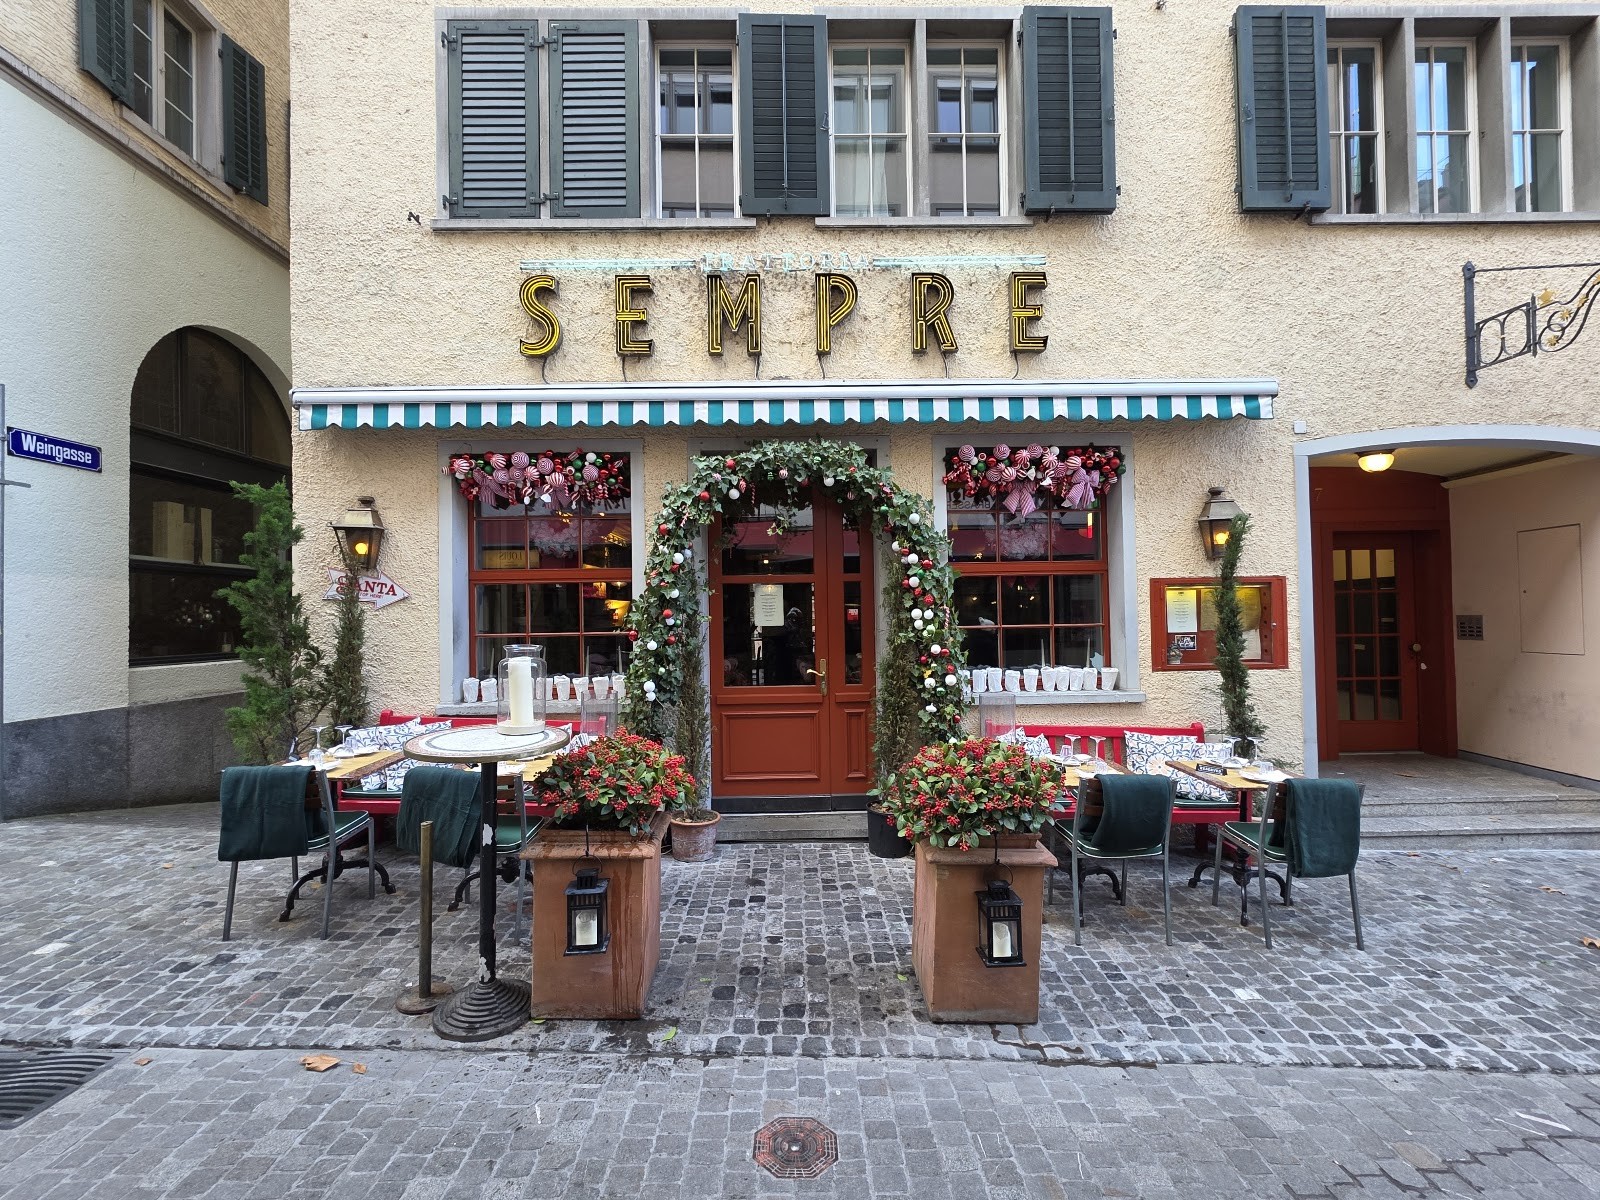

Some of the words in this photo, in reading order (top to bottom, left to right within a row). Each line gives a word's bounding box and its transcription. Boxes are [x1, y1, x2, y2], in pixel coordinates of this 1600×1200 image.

[702, 252, 870, 272] TRATTORIA
[519, 272, 1048, 357] SEMPRE
[20, 433, 92, 464] Weingasse
